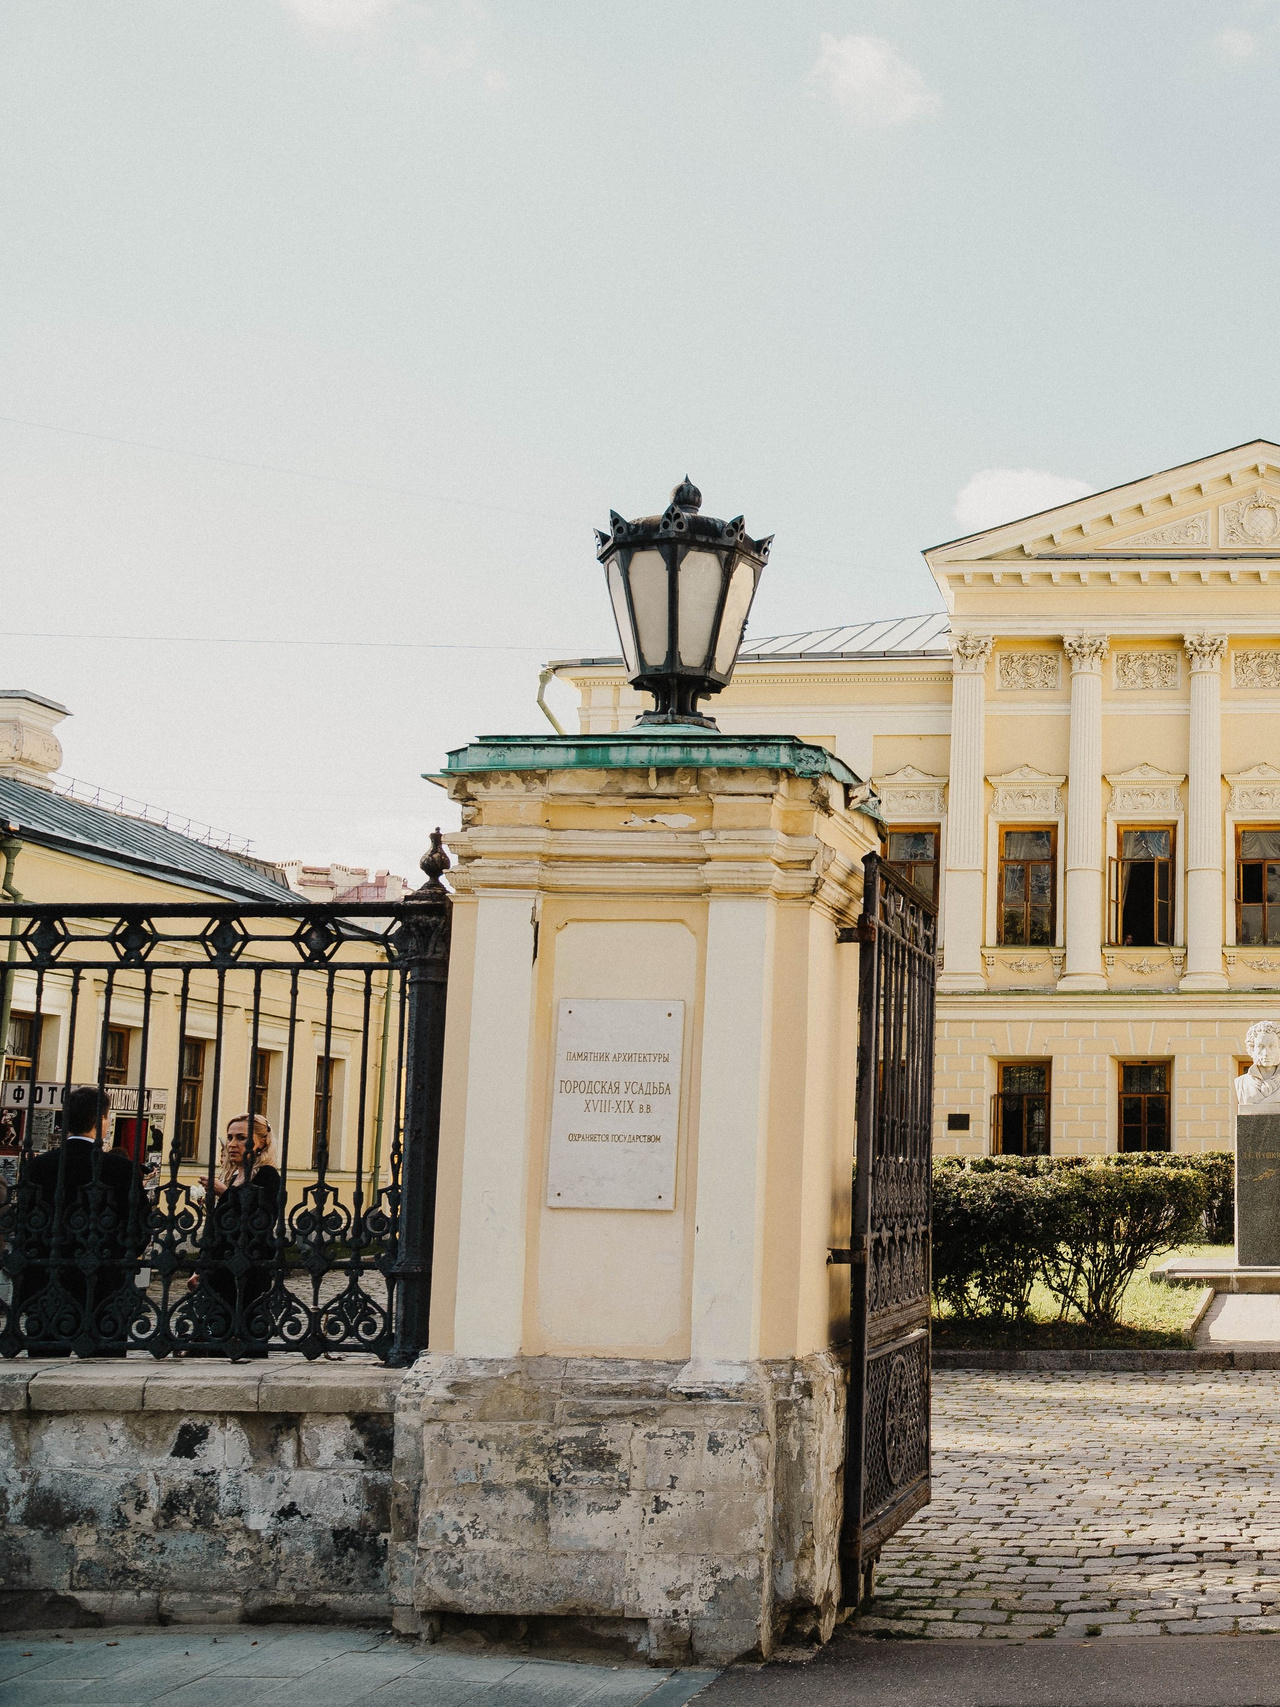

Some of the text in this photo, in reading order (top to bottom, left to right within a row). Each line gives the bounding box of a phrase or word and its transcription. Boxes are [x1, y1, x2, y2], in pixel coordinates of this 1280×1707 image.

[566, 1051, 670, 1063] ПАМЯТНИК АРХИТЕКТУРЫ
[559, 1080, 671, 1096] ГОРОДСКАЯ УСАДЬБА
[568, 1132, 661, 1144] ОХРАНЯЕТСЯ ГОСУДАРСТВОМ
